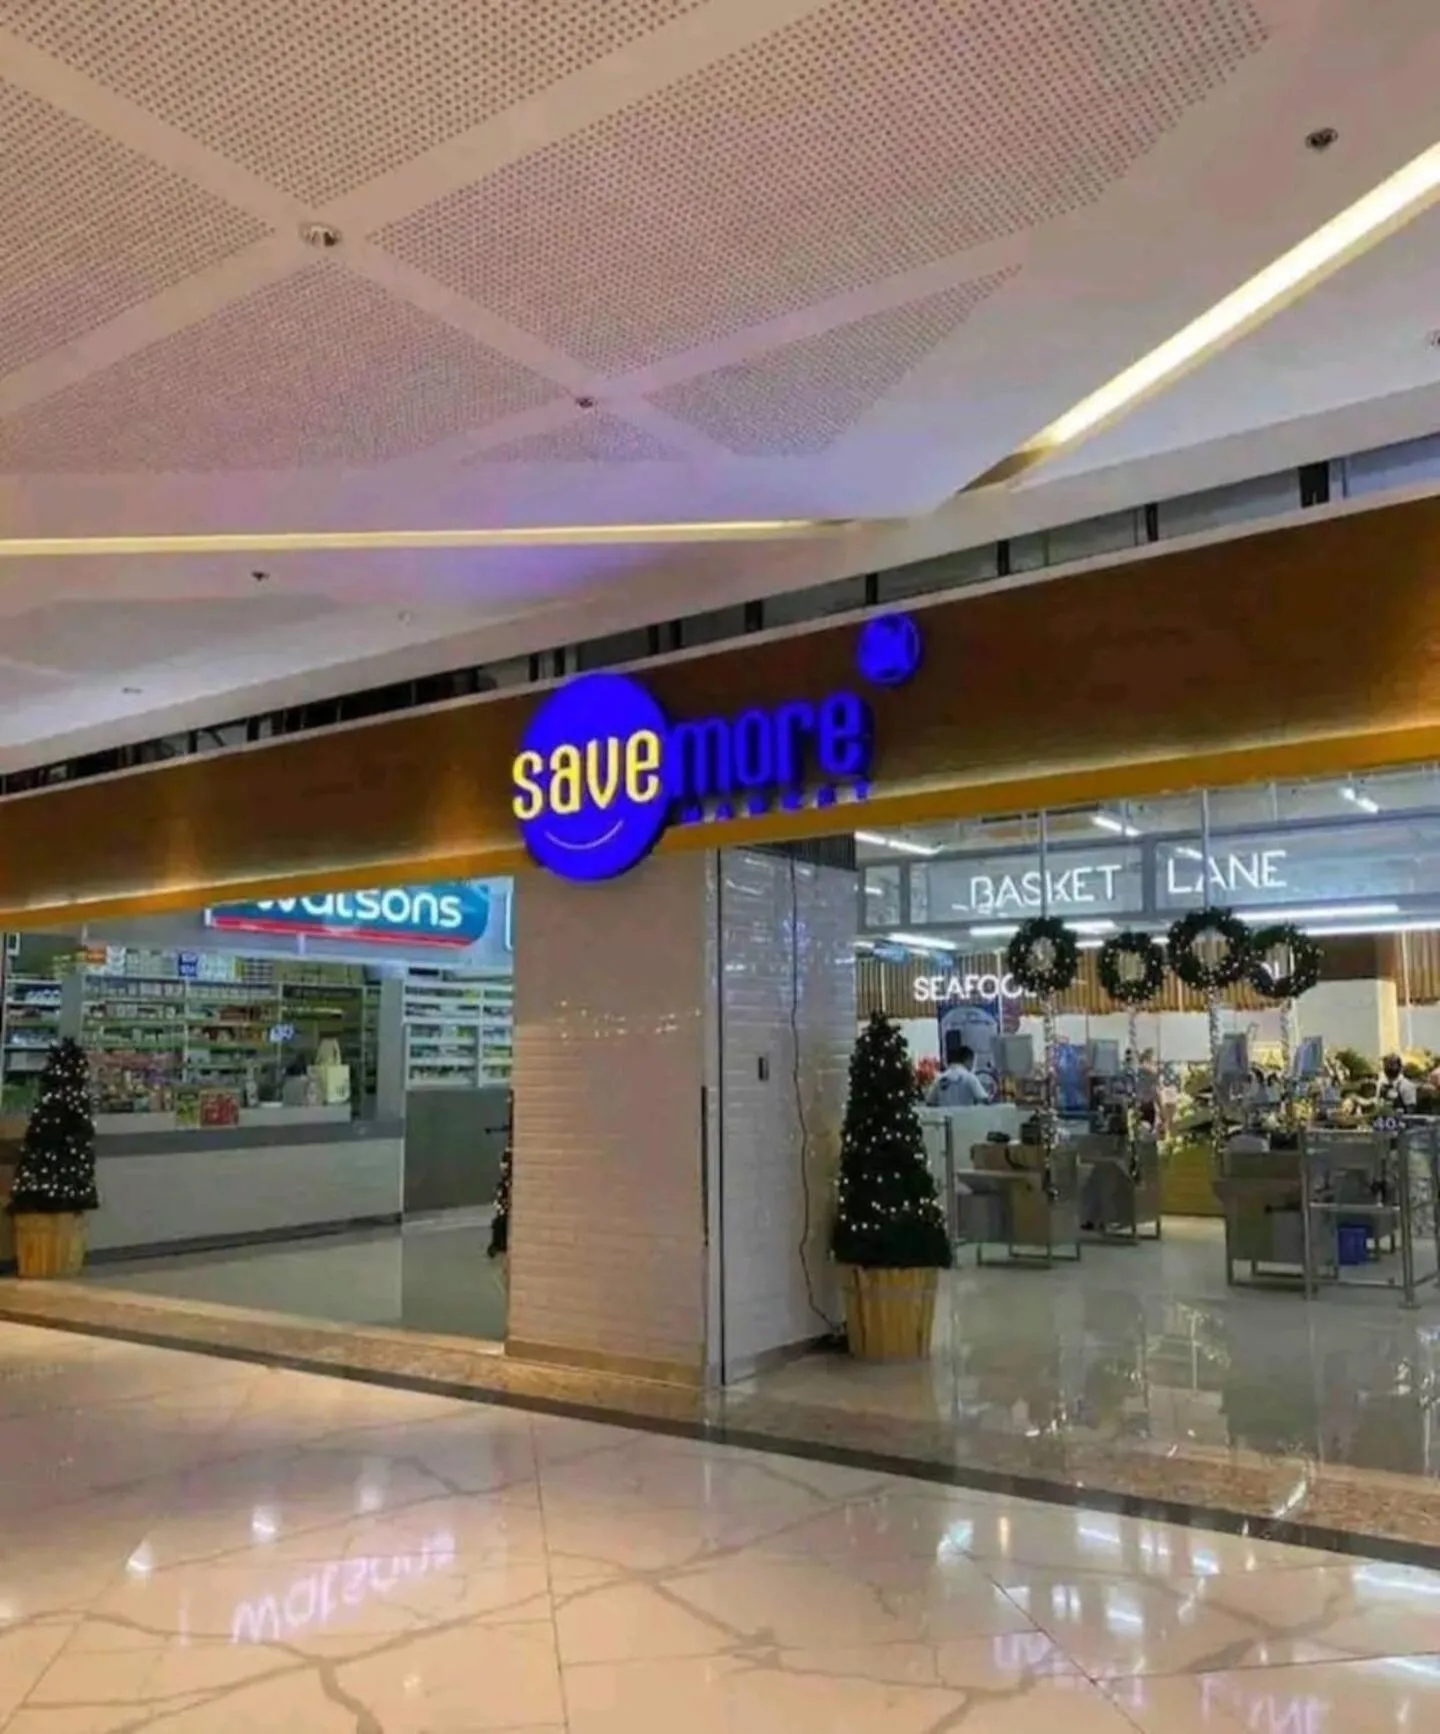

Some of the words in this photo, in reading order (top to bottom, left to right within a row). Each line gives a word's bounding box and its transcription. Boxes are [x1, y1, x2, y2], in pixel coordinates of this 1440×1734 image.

[512, 729, 661, 820] save
[671, 691, 866, 798] more
[970, 865, 1122, 910] BASKET
[1167, 850, 1288, 894] LANE
[913, 972, 1038, 1002] SEAFOO
